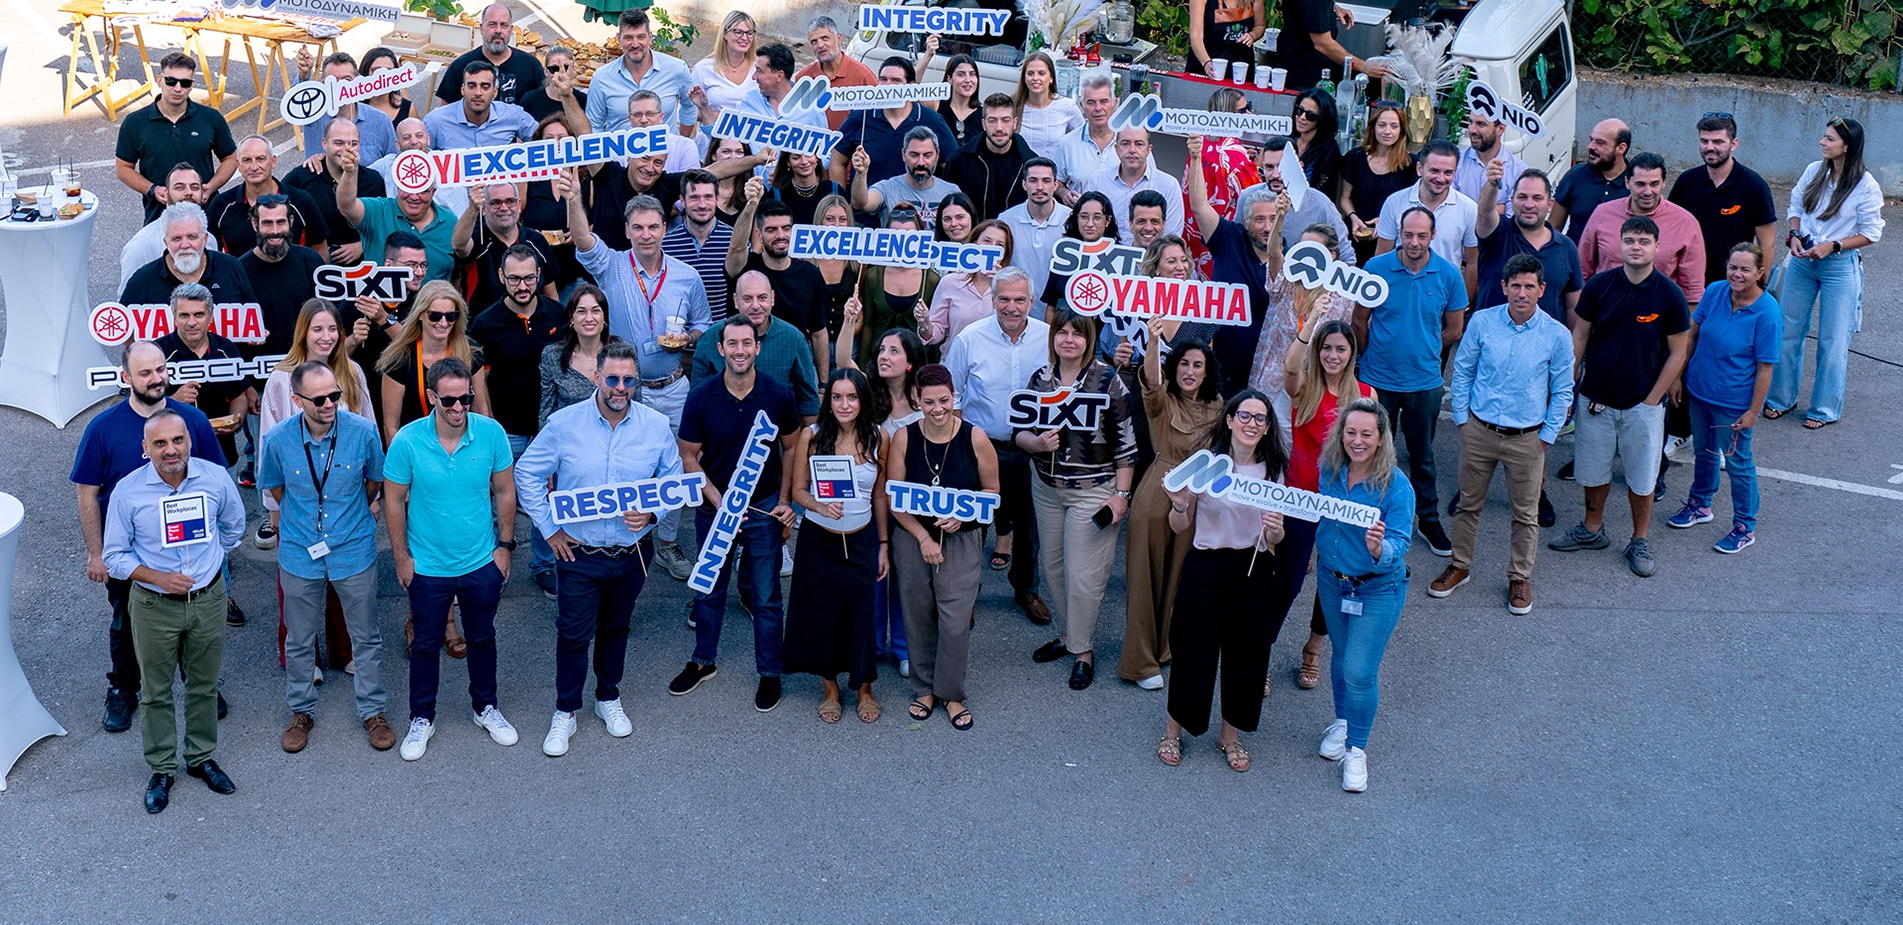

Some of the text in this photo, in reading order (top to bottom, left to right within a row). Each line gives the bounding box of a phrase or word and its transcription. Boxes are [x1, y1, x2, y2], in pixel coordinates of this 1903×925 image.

[863, 8, 1008, 33] INTEGRITY
[339, 68, 413, 101] Autodirect
[834, 86, 948, 101] ΜΟΤΟΔΥΝΑΜΙΚΗ
[717, 113, 841, 156] INTEGRITY
[1165, 112, 1288, 132] ΜΟΤΟΔΥΝΑΜΙΚΗ
[1502, 104, 1540, 134] NIO
[464, 129, 667, 177] EXCELLENCE
[794, 229, 933, 259] EXCELLENCE
[1112, 278, 1247, 322] YAMAHA
[1329, 266, 1382, 301] NIO
[132, 308, 261, 339] YAHA
[554, 477, 702, 520] RESPECT
[694, 416, 776, 589] INTEGRITY
[890, 485, 996, 520] TRUST
[1231, 492, 1317, 518] move evolve transform
[1233, 478, 1376, 524] ΜΟΤΟΔΥΝΑΜΙΚΗ
